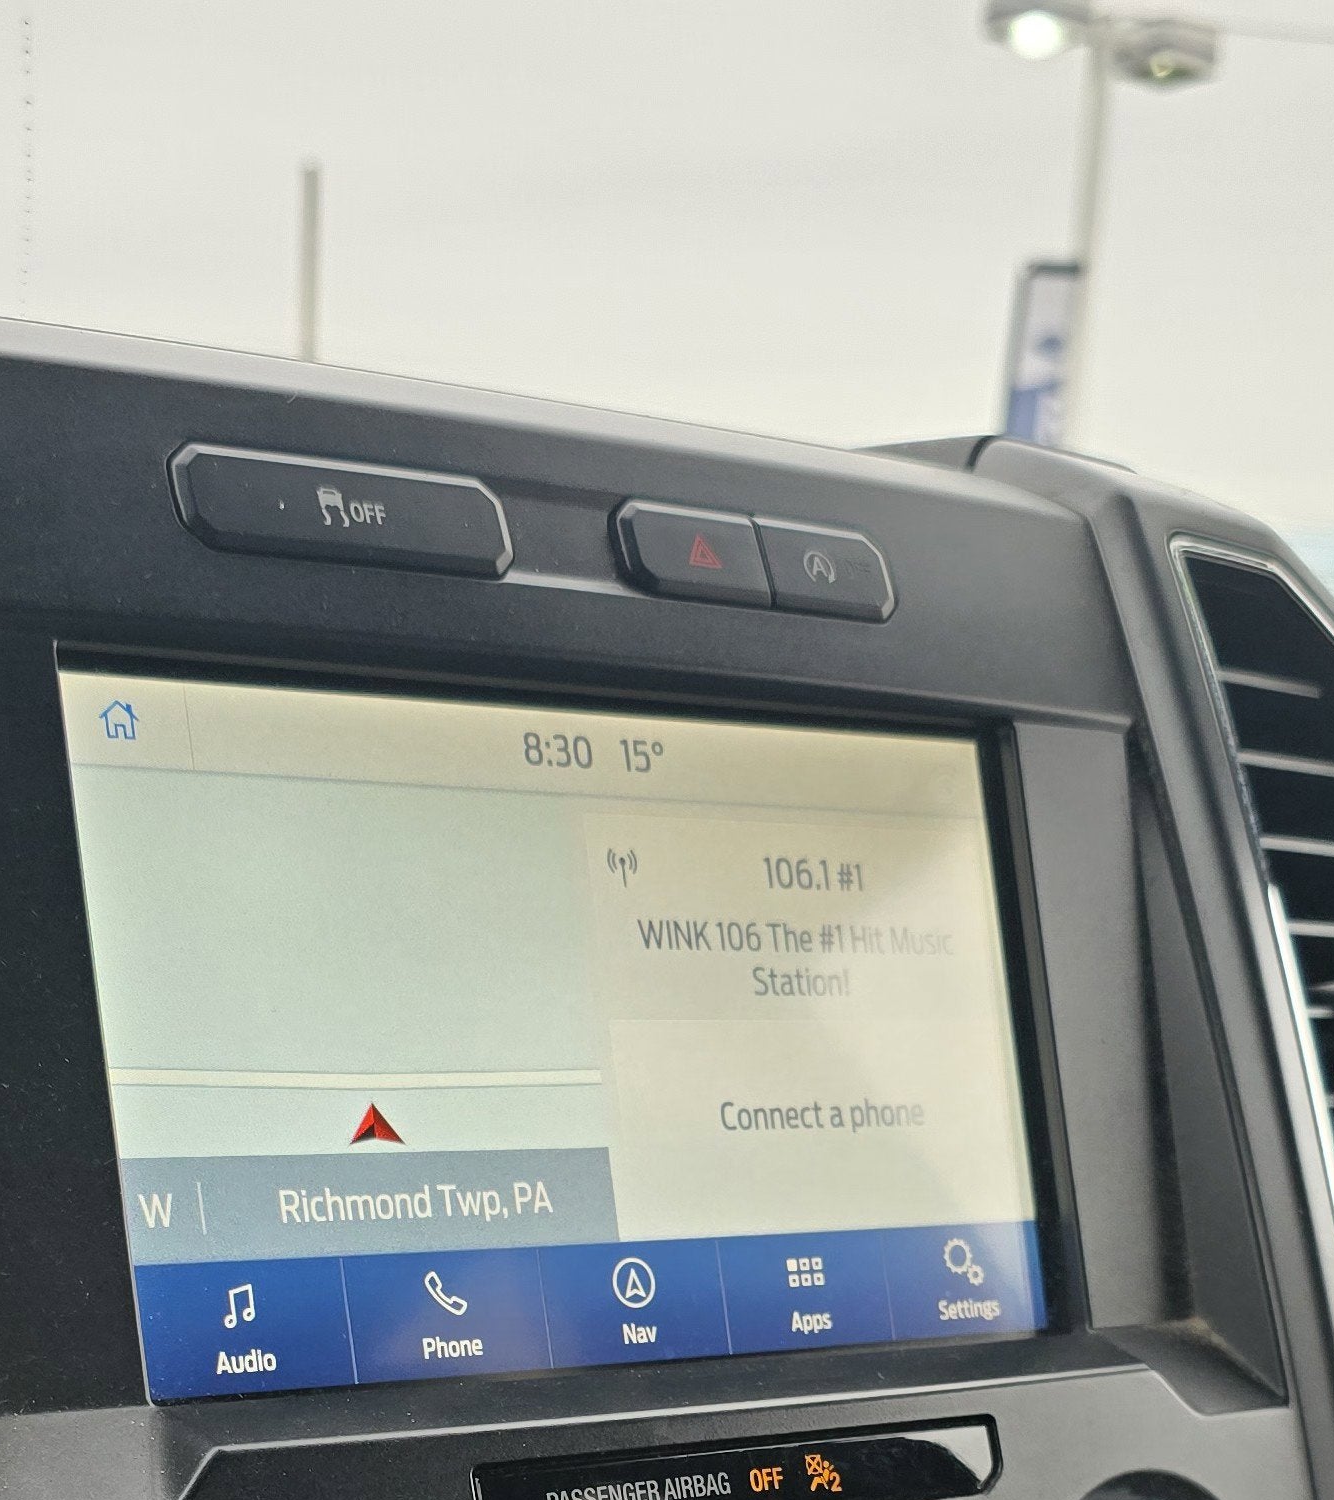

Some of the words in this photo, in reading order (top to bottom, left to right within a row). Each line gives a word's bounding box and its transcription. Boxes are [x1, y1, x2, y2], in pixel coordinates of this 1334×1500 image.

[349, 501, 386, 525] OFF
[523, 732, 593, 769] 8:30
[619, 738, 664, 773] 15°
[762, 857, 831, 891] 106.1
[837, 863, 864, 891] #1
[637, 919, 711, 951] WINK
[716, 922, 761, 952] 106
[765, 923, 812, 953] The
[819, 925, 843, 953] #1
[850, 925, 883, 954] Hit
[890, 926, 955, 956] Music
[753, 967, 850, 997] Station!
[720, 1101, 823, 1131] Connect
[829, 1109, 845, 1127] a
[850, 1099, 925, 1133] phone
[138, 1193, 172, 1228] W
[279, 1184, 432, 1223] Richmond
[436, 1183, 508, 1222] Twp,
[513, 1181, 553, 1214] PA
[791, 1309, 833, 1334] Apps
[938, 1296, 1001, 1322] Settings
[422, 1336, 484, 1360] Phone
[623, 1323, 657, 1345] Nav
[216, 1349, 277, 1375] Audio
[664, 1472, 731, 1500] AIRBAG
[749, 1467, 784, 1492] OFF
